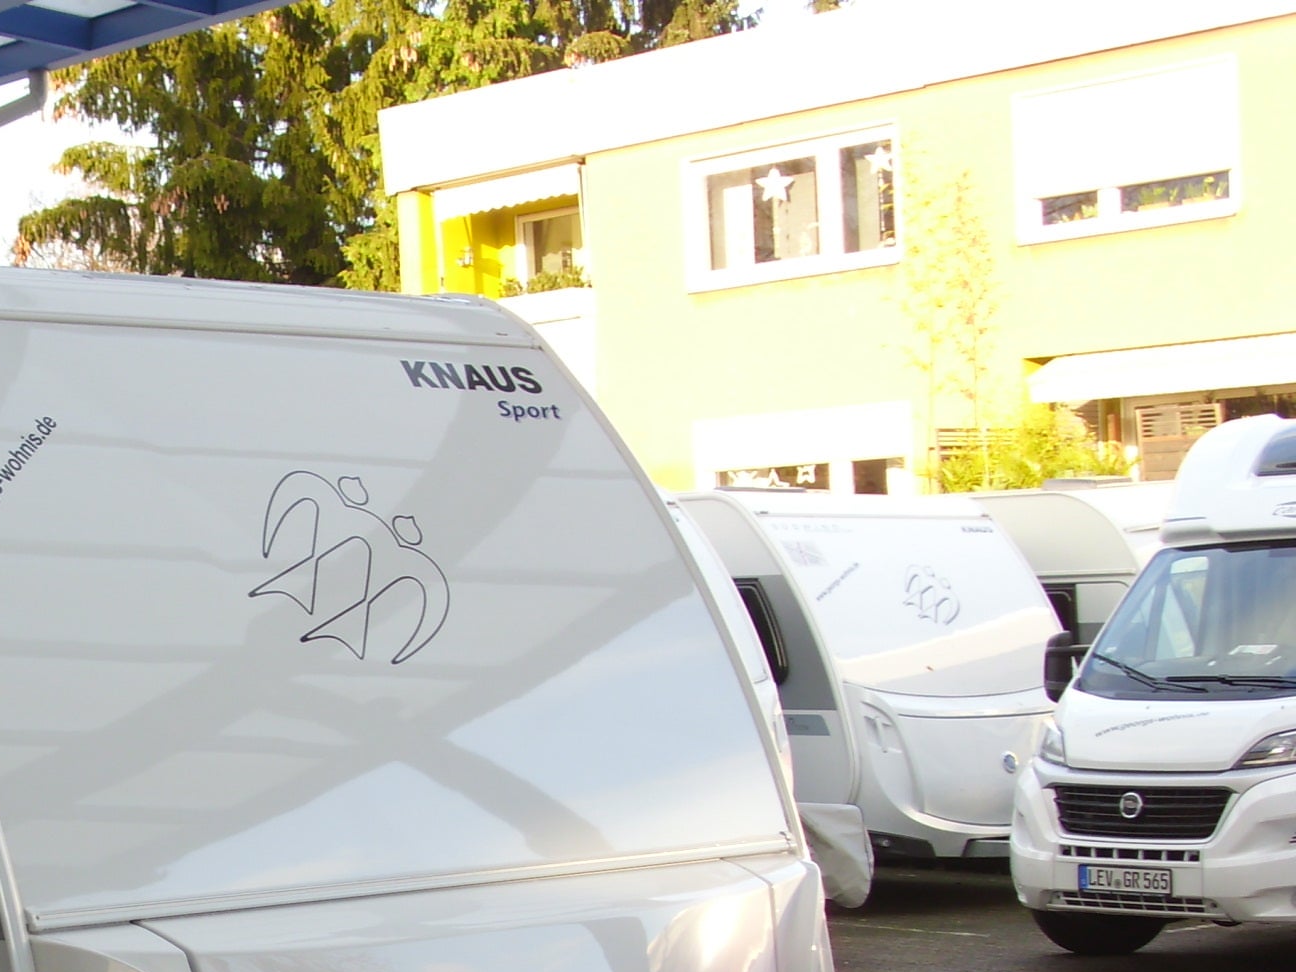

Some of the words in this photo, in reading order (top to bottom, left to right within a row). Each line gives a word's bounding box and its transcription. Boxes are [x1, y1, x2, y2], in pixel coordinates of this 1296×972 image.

[399, 359, 542, 394] KNAUS
[497, 400, 561, 422] Sport
[1088, 869, 1113, 887] LEV
[1123, 871, 1140, 888] GR
[1143, 873, 1169, 890] 565
